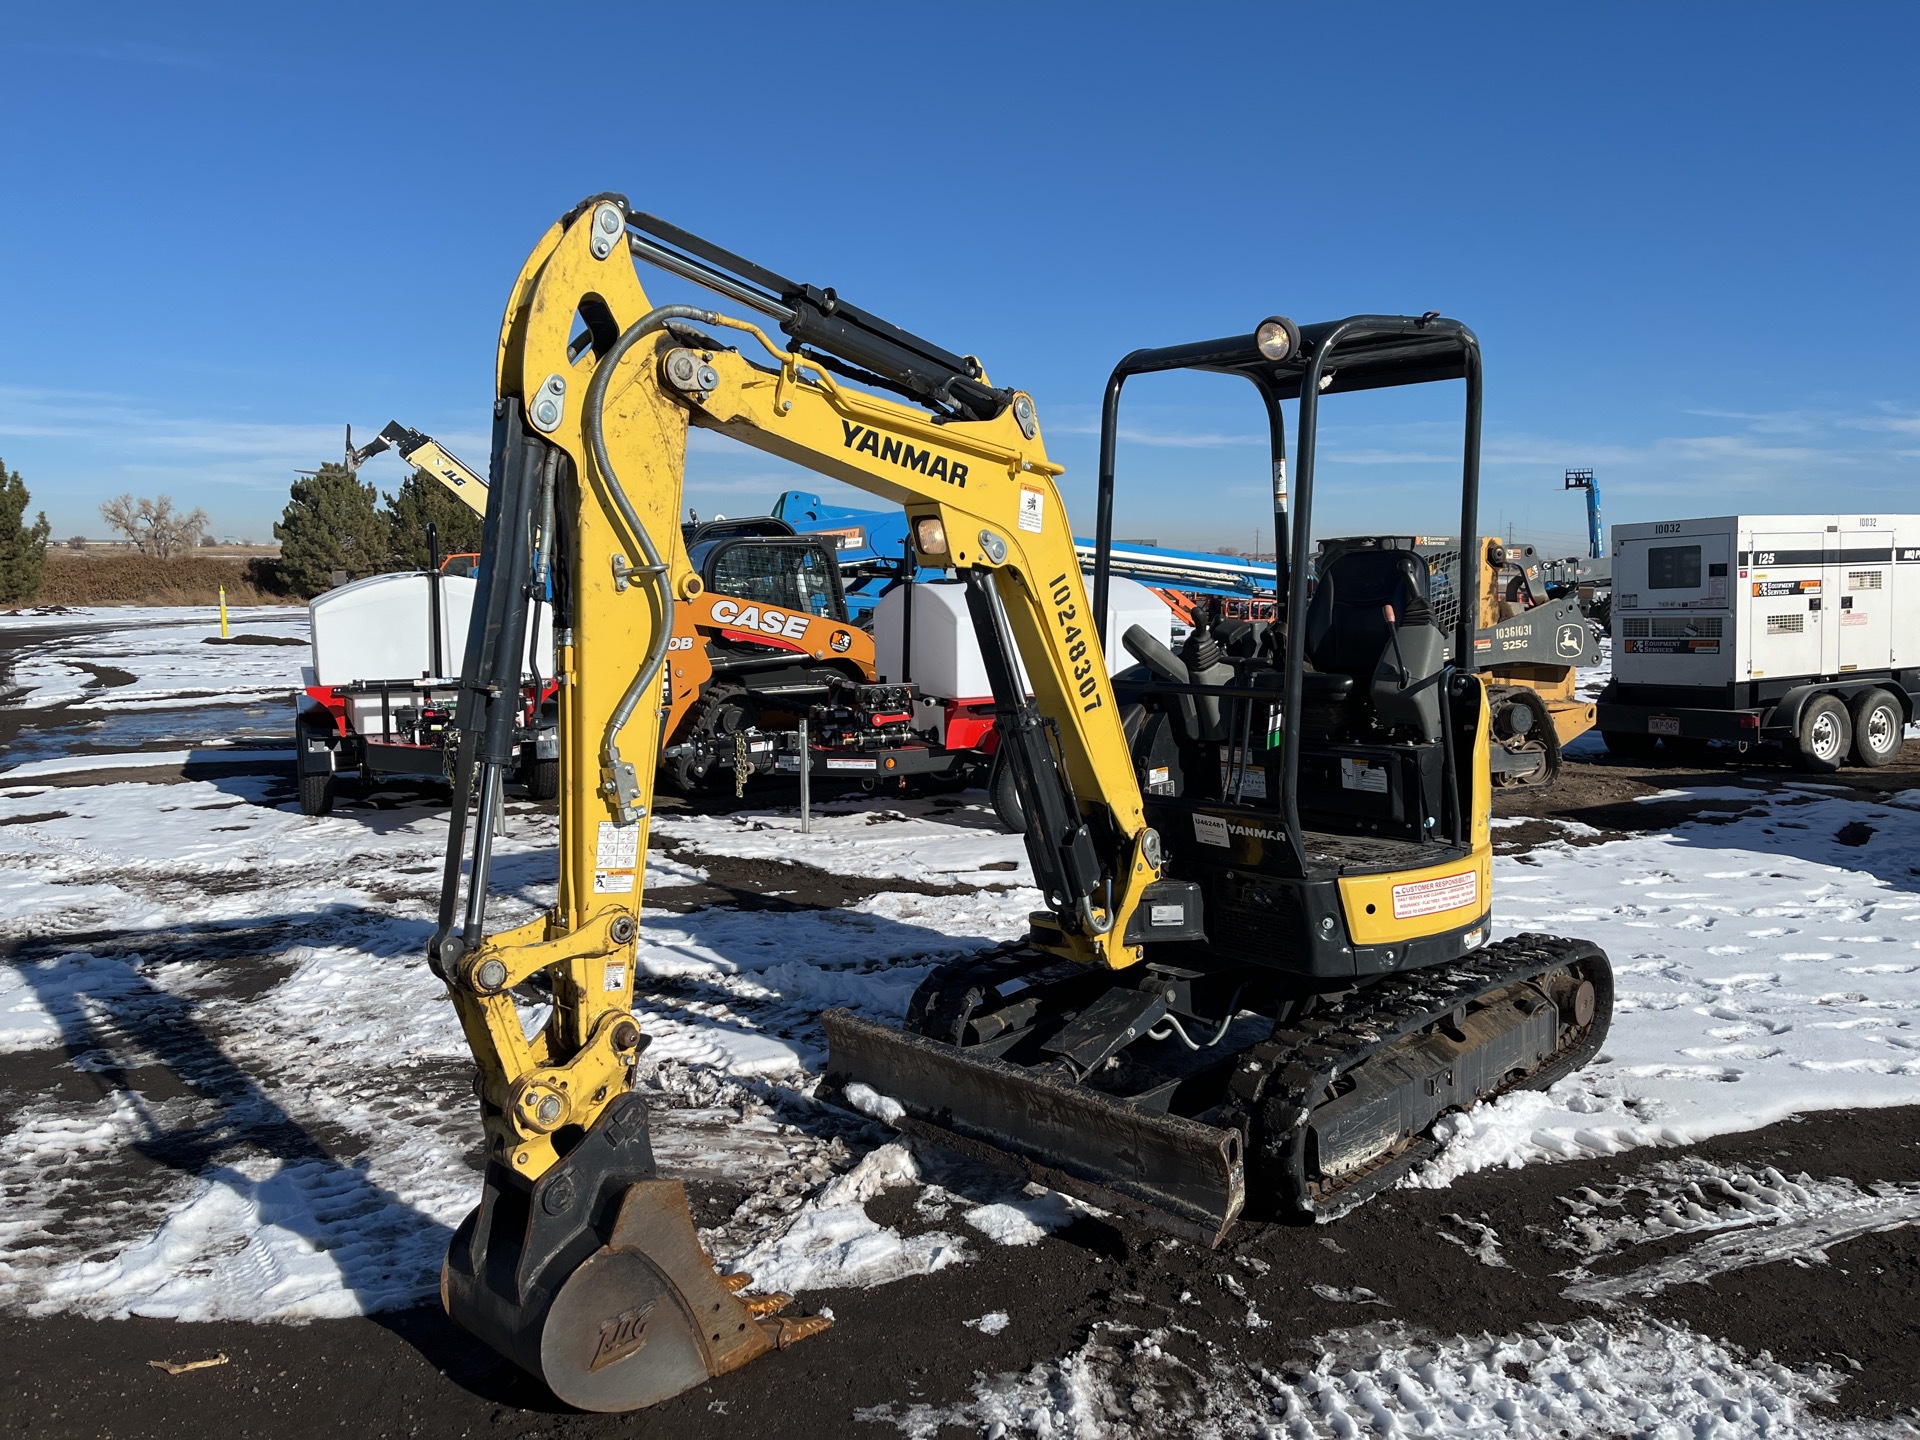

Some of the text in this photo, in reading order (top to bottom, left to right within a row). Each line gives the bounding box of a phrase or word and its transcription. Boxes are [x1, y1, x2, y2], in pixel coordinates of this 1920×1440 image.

[841, 419, 969, 489] YANMAR
[441, 469, 467, 487] JLG
[1655, 523, 1681, 535] 10032
[1859, 518, 1877, 527] 10032
[1758, 553, 1775, 565] 125
[710, 600, 811, 640] CASE
[1496, 624, 1532, 640] 10361031
[1049, 573, 1102, 713] 10248307
[1502, 640, 1528, 650] 325G
[1227, 824, 1286, 842] YANMAR
[1402, 875, 1471, 894] CUSTOMER RESPONSIBILITY
